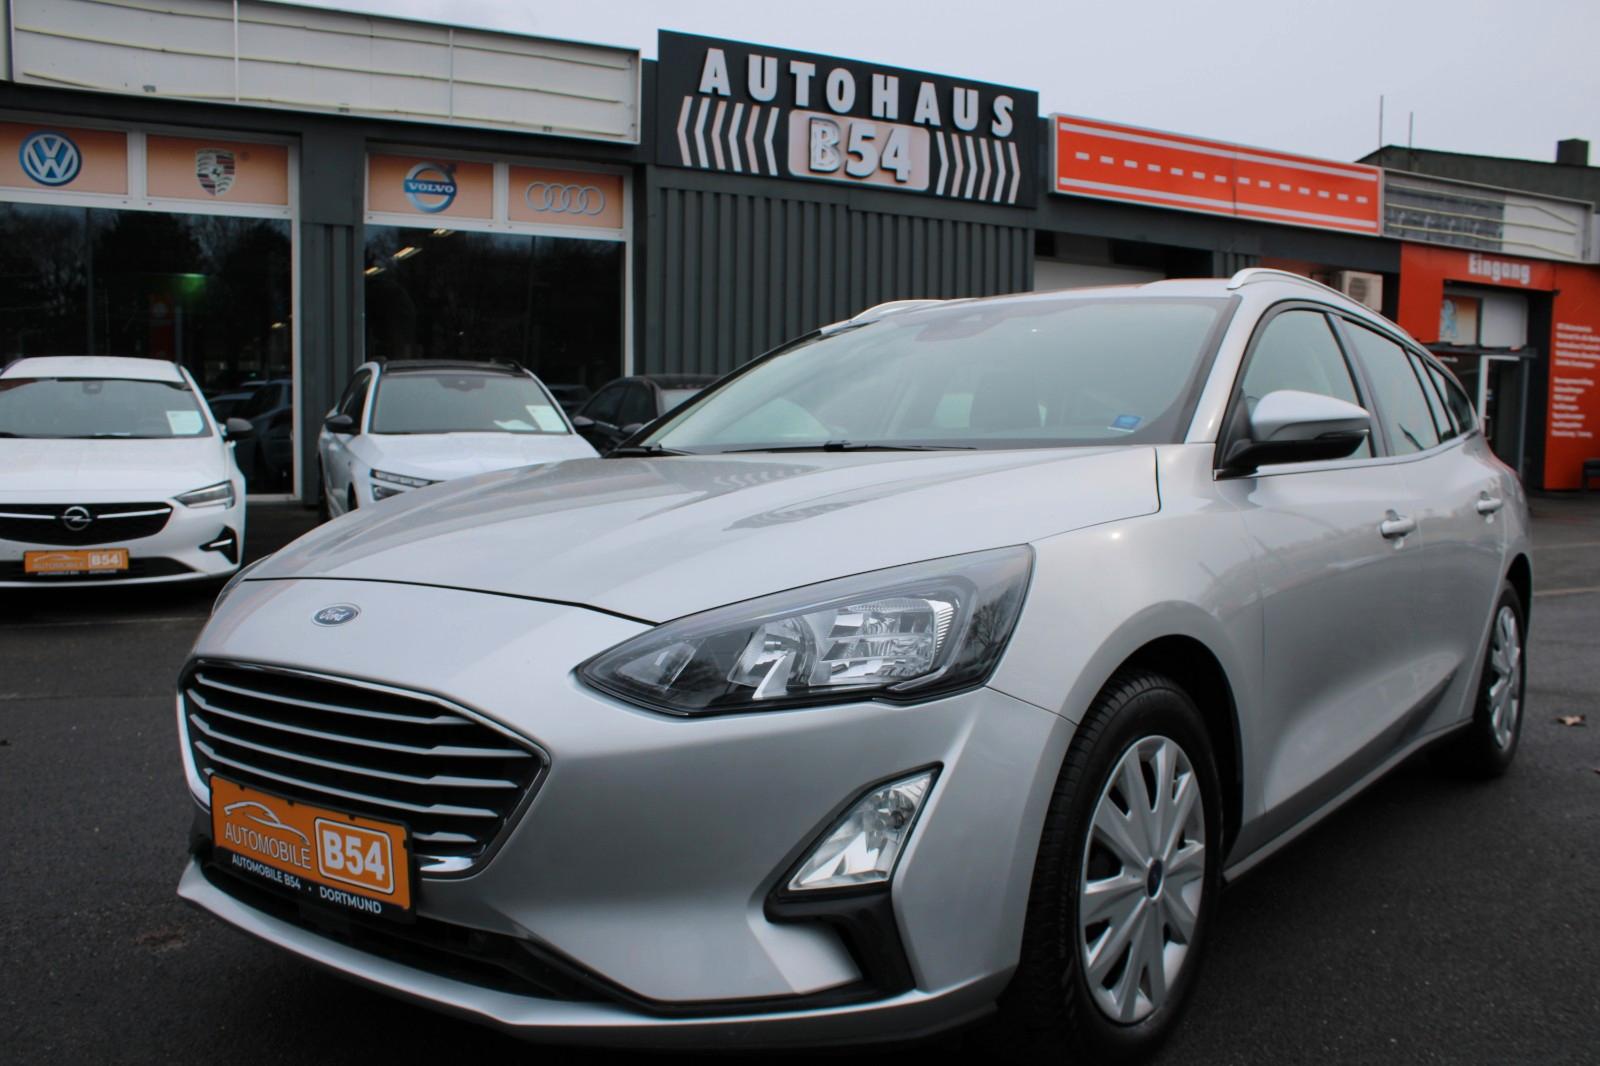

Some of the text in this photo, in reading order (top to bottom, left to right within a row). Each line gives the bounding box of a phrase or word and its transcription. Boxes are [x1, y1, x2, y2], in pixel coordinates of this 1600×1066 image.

[699, 48, 1014, 138] AUTOHAUS
[808, 117, 911, 182] B54
[408, 181, 455, 193] VOLVO
[1468, 253, 1531, 285] Eingang
[91, 554, 120, 567] B54
[318, 607, 350, 621] Ford
[224, 822, 385, 881] AUTOMOBILE B54
[232, 853, 382, 914] AUTOMOBILE B54 DORTMUND
